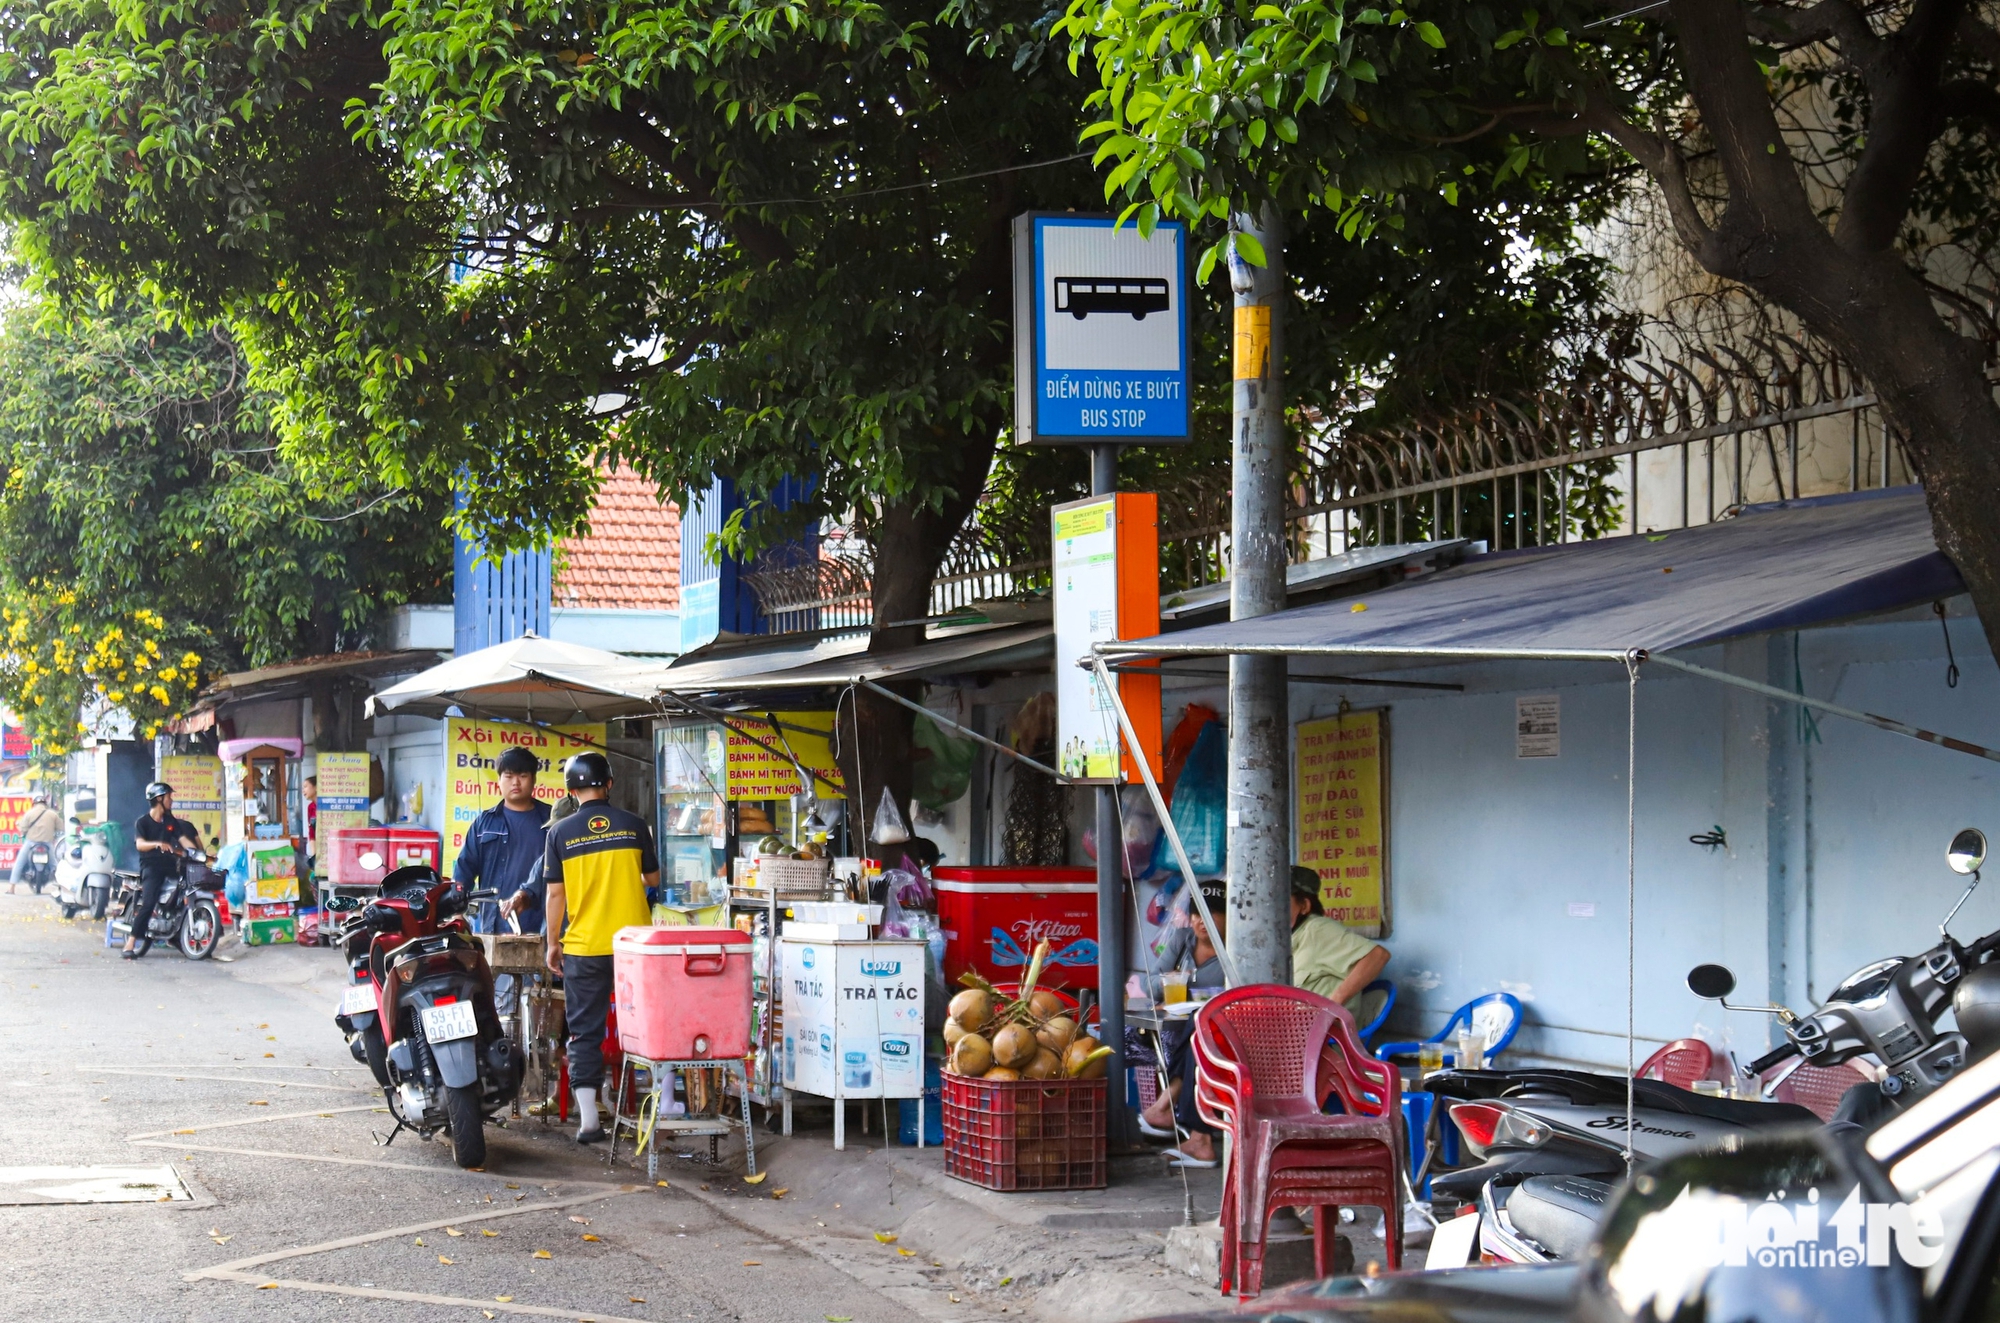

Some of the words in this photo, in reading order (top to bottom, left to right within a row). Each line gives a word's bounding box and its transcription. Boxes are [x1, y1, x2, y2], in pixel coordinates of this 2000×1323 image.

[1046, 374, 1080, 398] ĐIỂM
[1084, 376, 1122, 399] DỪNG
[1126, 381, 1142, 399] XE
[1147, 377, 1180, 399] BUÝT
[1081, 409, 1108, 427] BUS
[1112, 410, 1146, 428] STOP
[457, 727, 493, 743] Xôi
[501, 731, 548, 750] Mặn
[456, 753, 496, 768] Bán
[729, 751, 755, 762] BÁNH
[729, 768, 755, 779] BÁNH
[758, 767, 769, 779] MÌ
[771, 769, 792, 781] THỊT
[1327, 765, 1356, 781] TẮC
[455, 780, 482, 795] Bún
[487, 781, 501, 796] Th
[532, 782, 565, 799] ướng
[730, 785, 749, 795] BÚN
[752, 786, 772, 797] THỊT
[775, 784, 802, 795] NƯỚN
[565, 839, 580, 847] CAR
[581, 835, 600, 843] QUICK
[1324, 846, 1344, 859] ÉP
[1324, 883, 1352, 899] TẮC
[1011, 920, 1081, 942] Hitaco
[794, 978, 808, 997] TRÀ
[809, 975, 824, 998] TẮC
[843, 984, 876, 1000] TRÀ
[884, 982, 918, 1000] TẮC
[430, 1006, 465, 1025] 59-F1
[430, 1019, 474, 1040] 960.46
[883, 1042, 908, 1055] Cozy
[1641, 1126, 1696, 1139] mode
